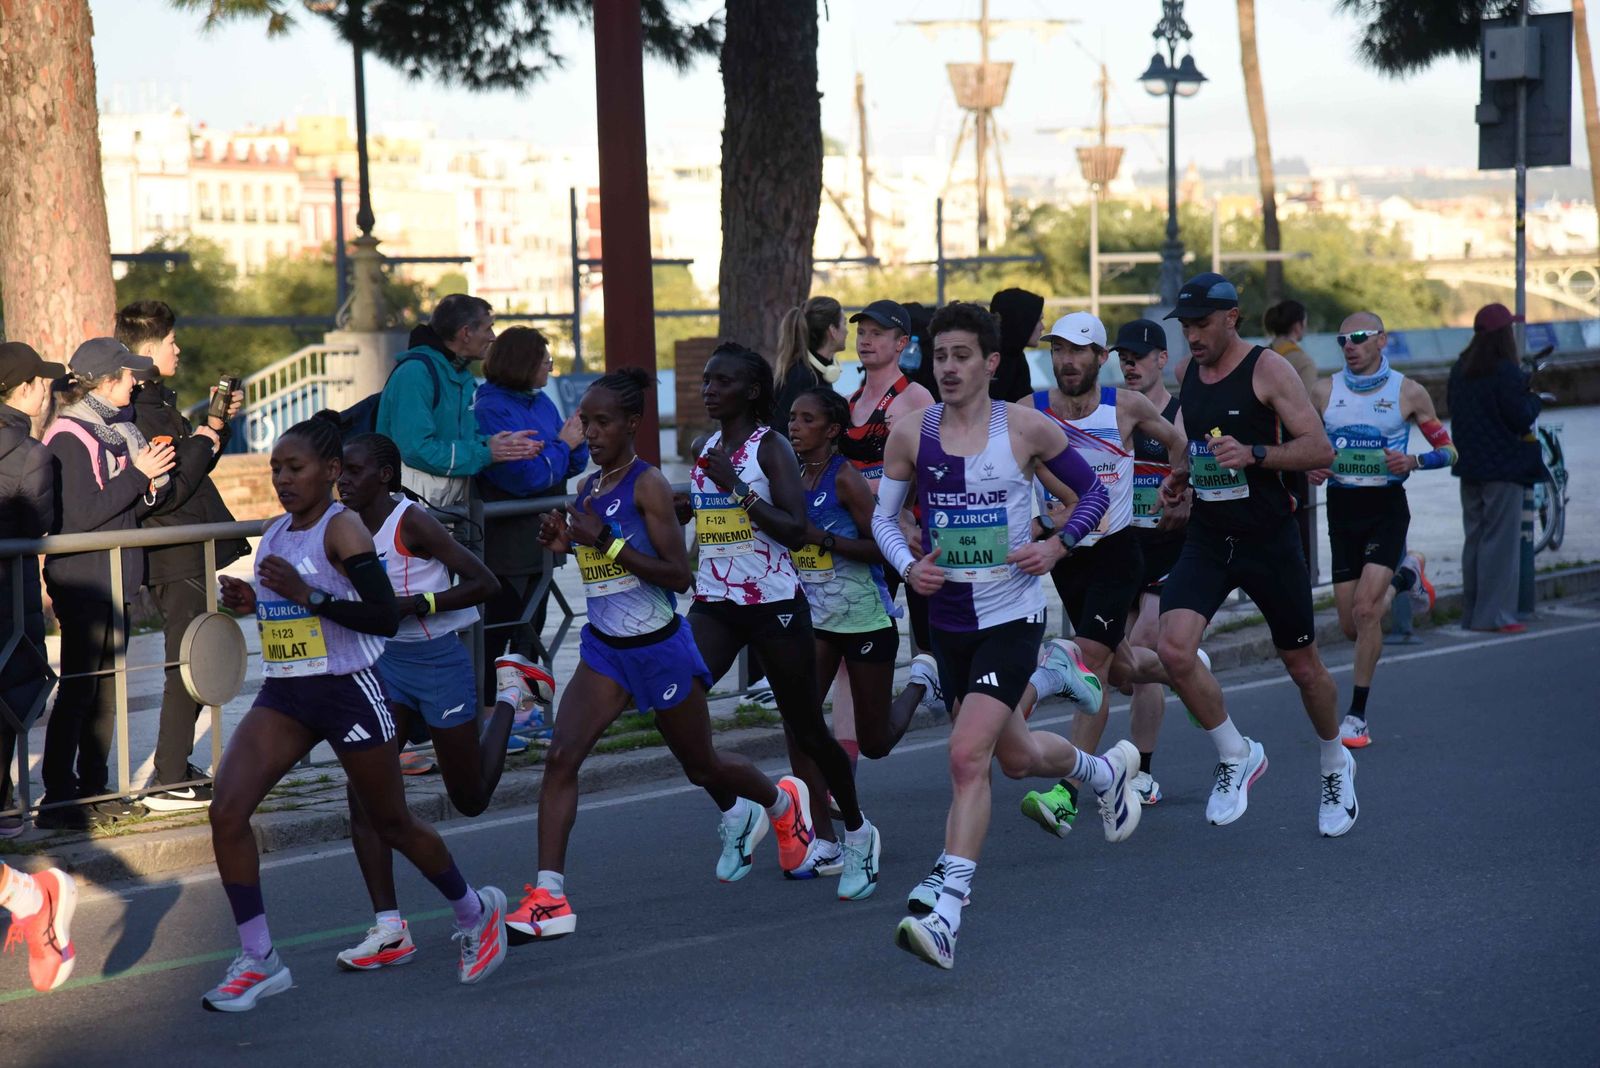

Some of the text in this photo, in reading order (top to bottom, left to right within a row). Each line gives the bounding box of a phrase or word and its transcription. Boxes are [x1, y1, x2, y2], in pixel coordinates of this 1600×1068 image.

[1091, 462, 1116, 473] nchip
[1338, 463, 1381, 474] BURGOS
[862, 468, 884, 479] URIC
[1133, 477, 1159, 485] URICH
[705, 497, 729, 506] ZURIC
[706, 516, 726, 525] F-124
[953, 513, 998, 524] ZURICH
[699, 528, 752, 544] EPKWEMOI
[959, 536, 976, 546] 464
[946, 550, 994, 565] ALLAN
[583, 562, 627, 580] ZUNES
[269, 605, 307, 617] ZURICH
[272, 628, 294, 640] F-123
[268, 642, 308, 660] MULAT
